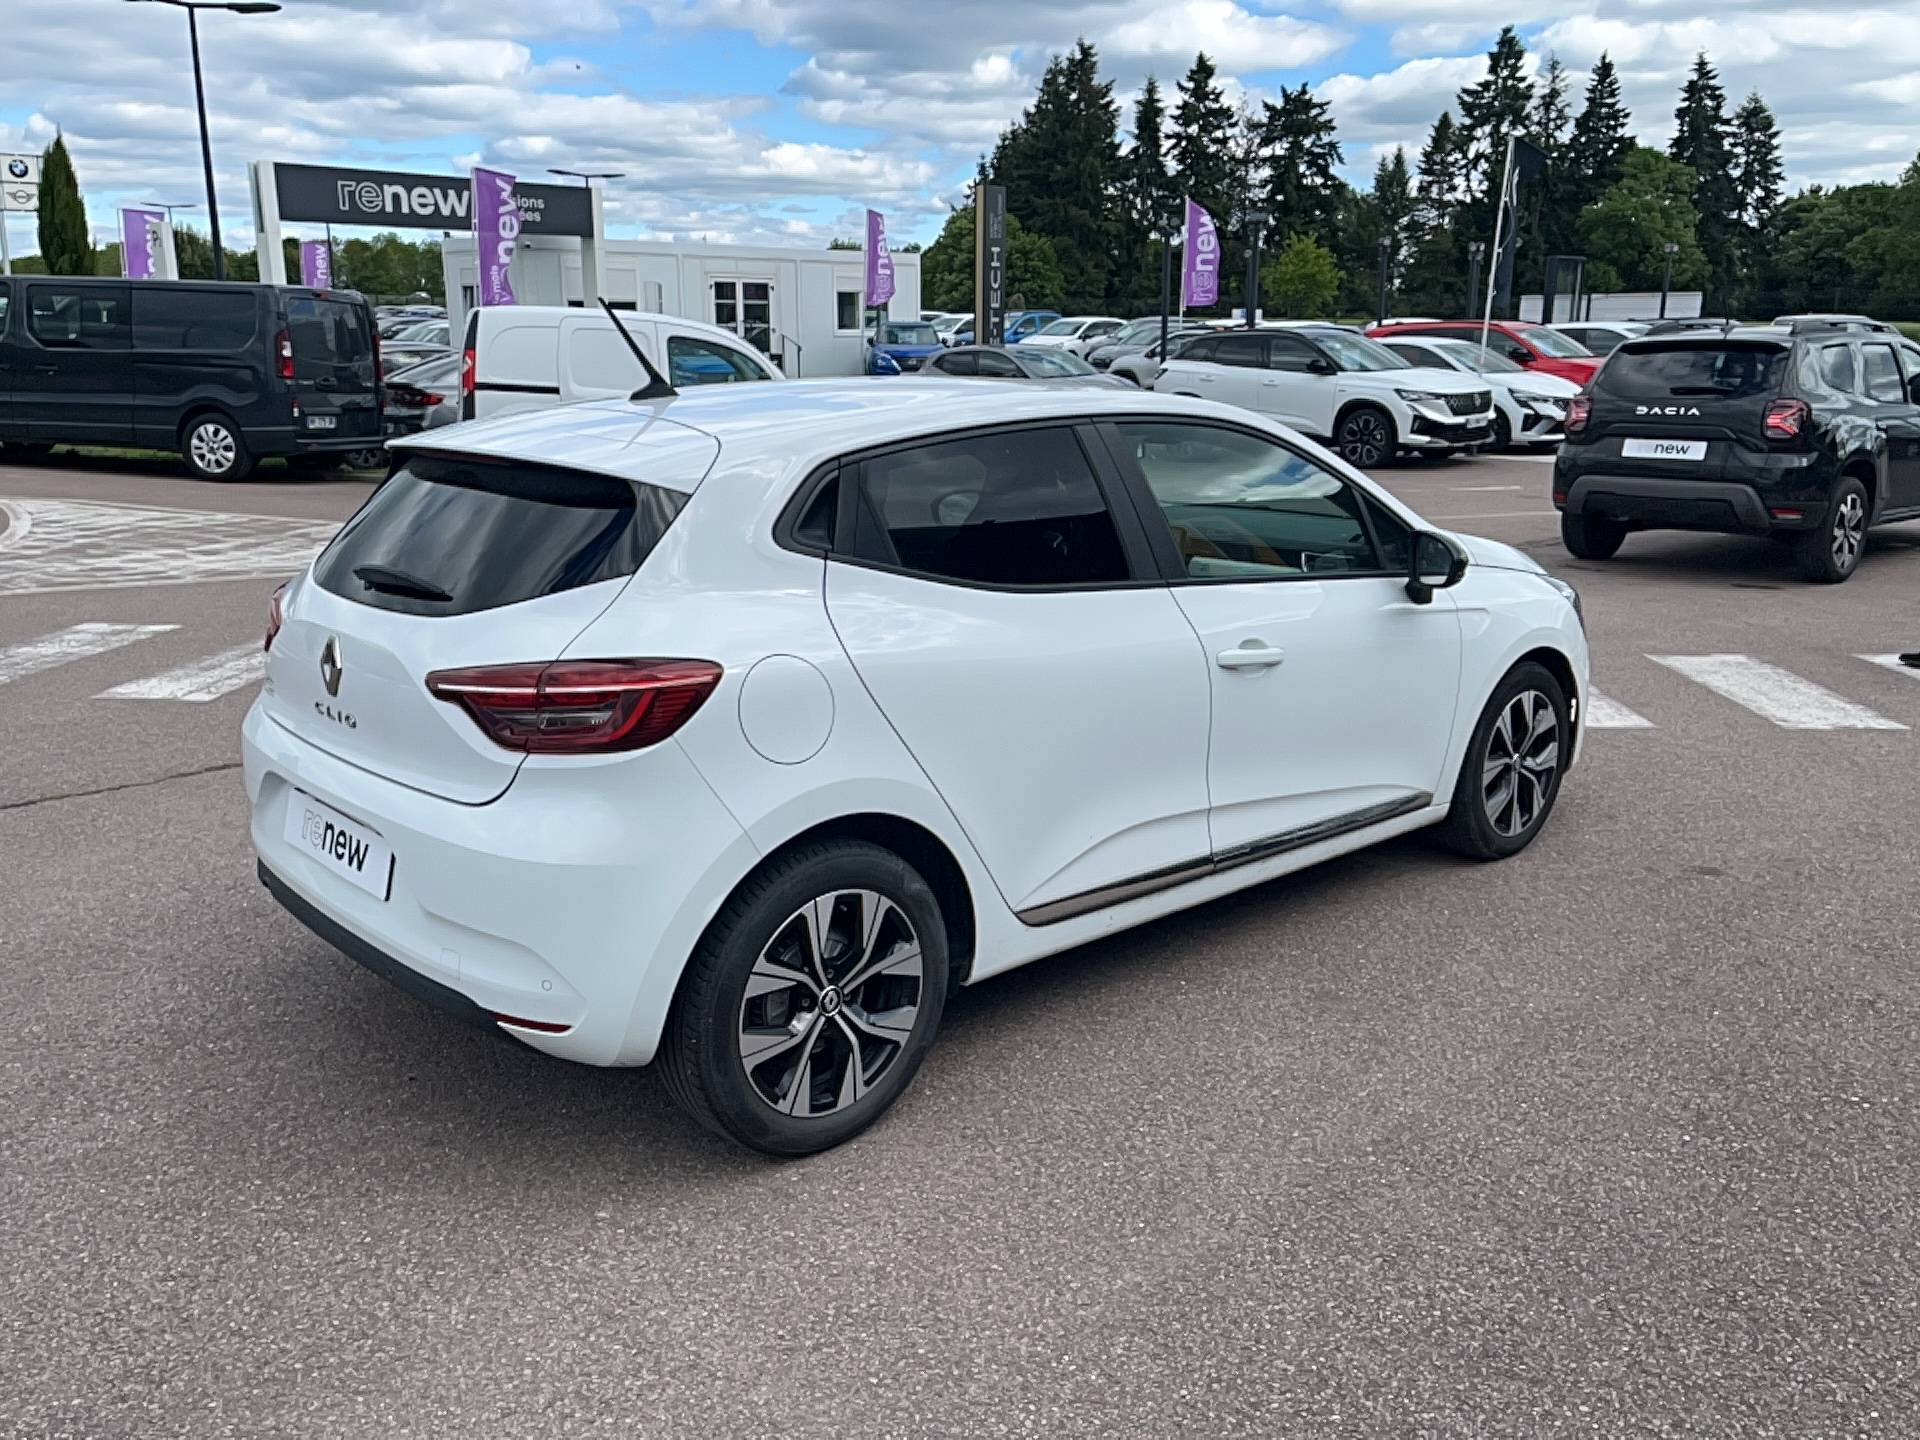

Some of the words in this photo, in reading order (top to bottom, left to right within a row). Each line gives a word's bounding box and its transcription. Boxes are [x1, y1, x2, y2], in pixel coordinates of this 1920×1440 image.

[336, 180, 471, 218] renew
[1635, 406, 1700, 416] DACIA
[315, 701, 357, 729] CLIO
[302, 808, 370, 873] renew
